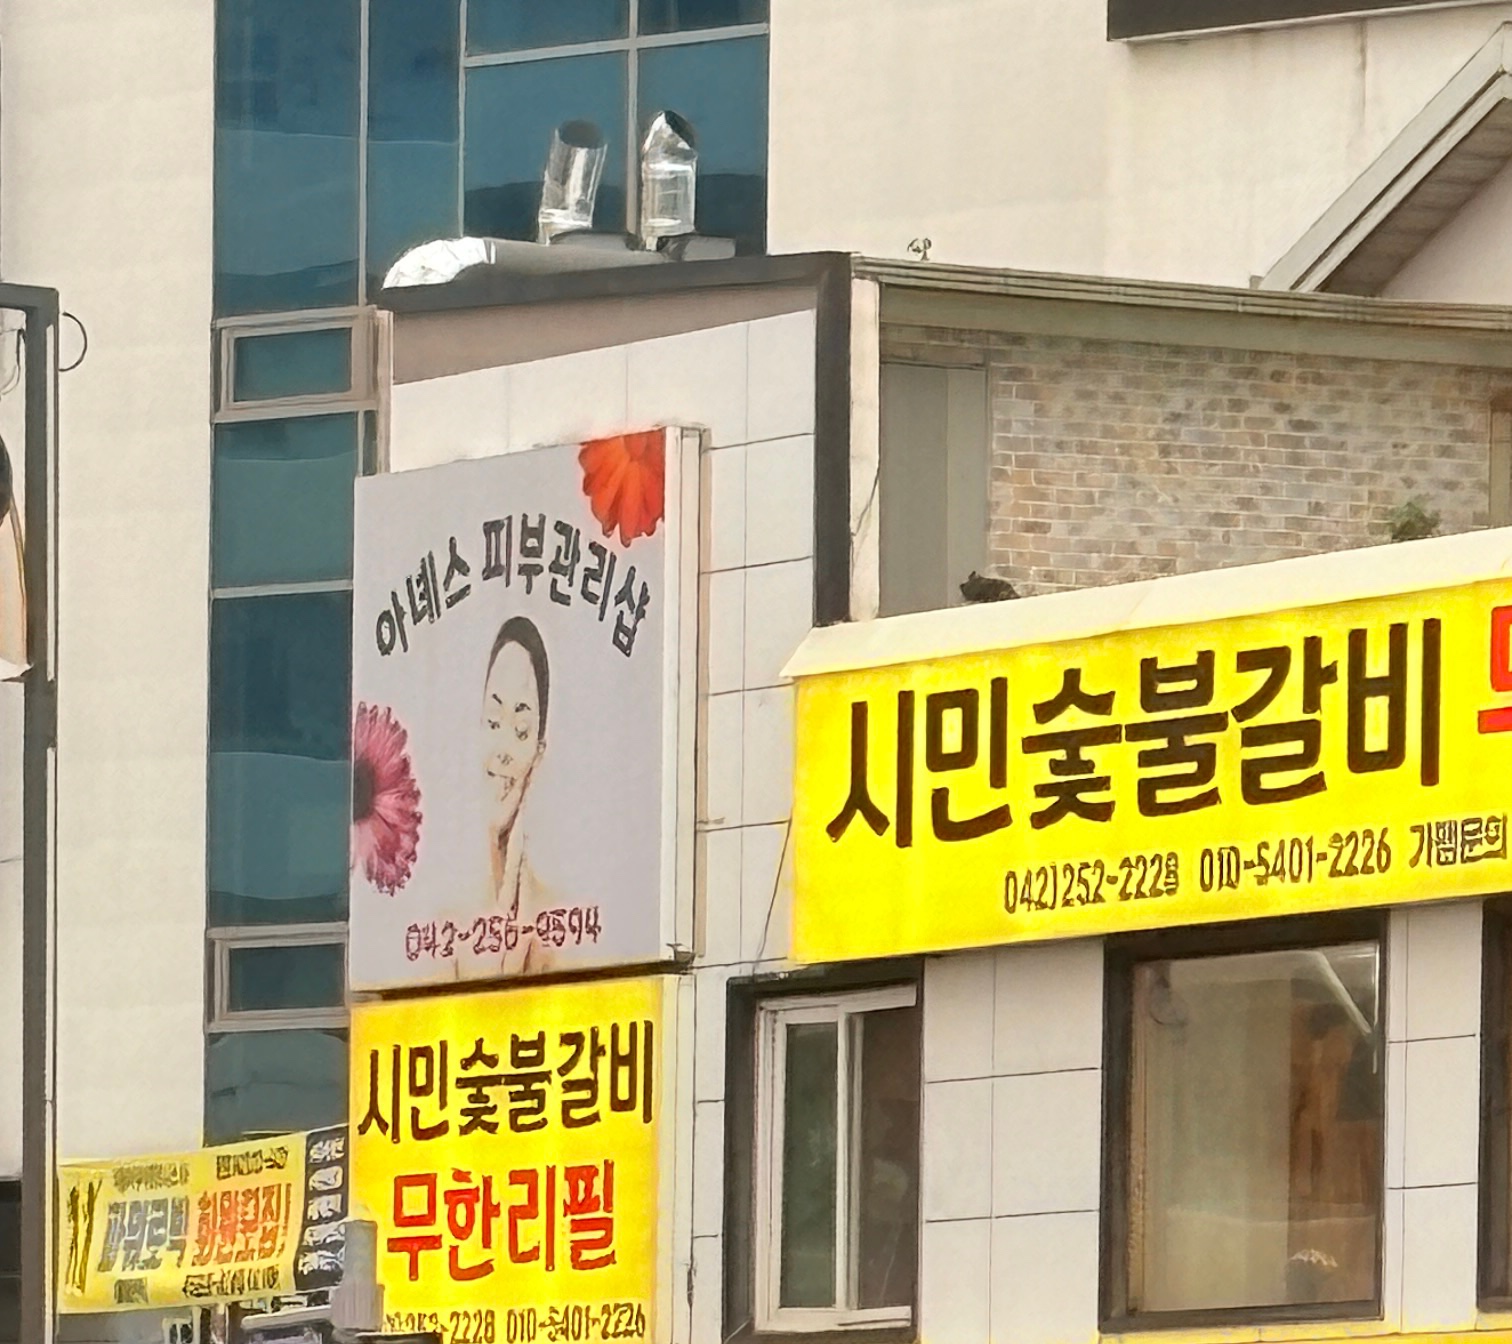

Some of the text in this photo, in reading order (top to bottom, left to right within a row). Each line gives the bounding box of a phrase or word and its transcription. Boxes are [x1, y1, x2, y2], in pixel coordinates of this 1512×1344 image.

[482, 513, 651, 657] 피부관리샵
[825, 618, 1441, 849] 시민숯불갈비
[1200, 827, 1392, 893] 010-5401-2226
[357, 1020, 655, 1144] 시민숯불갈비
[387, 1159, 618, 1282] 무한리필
